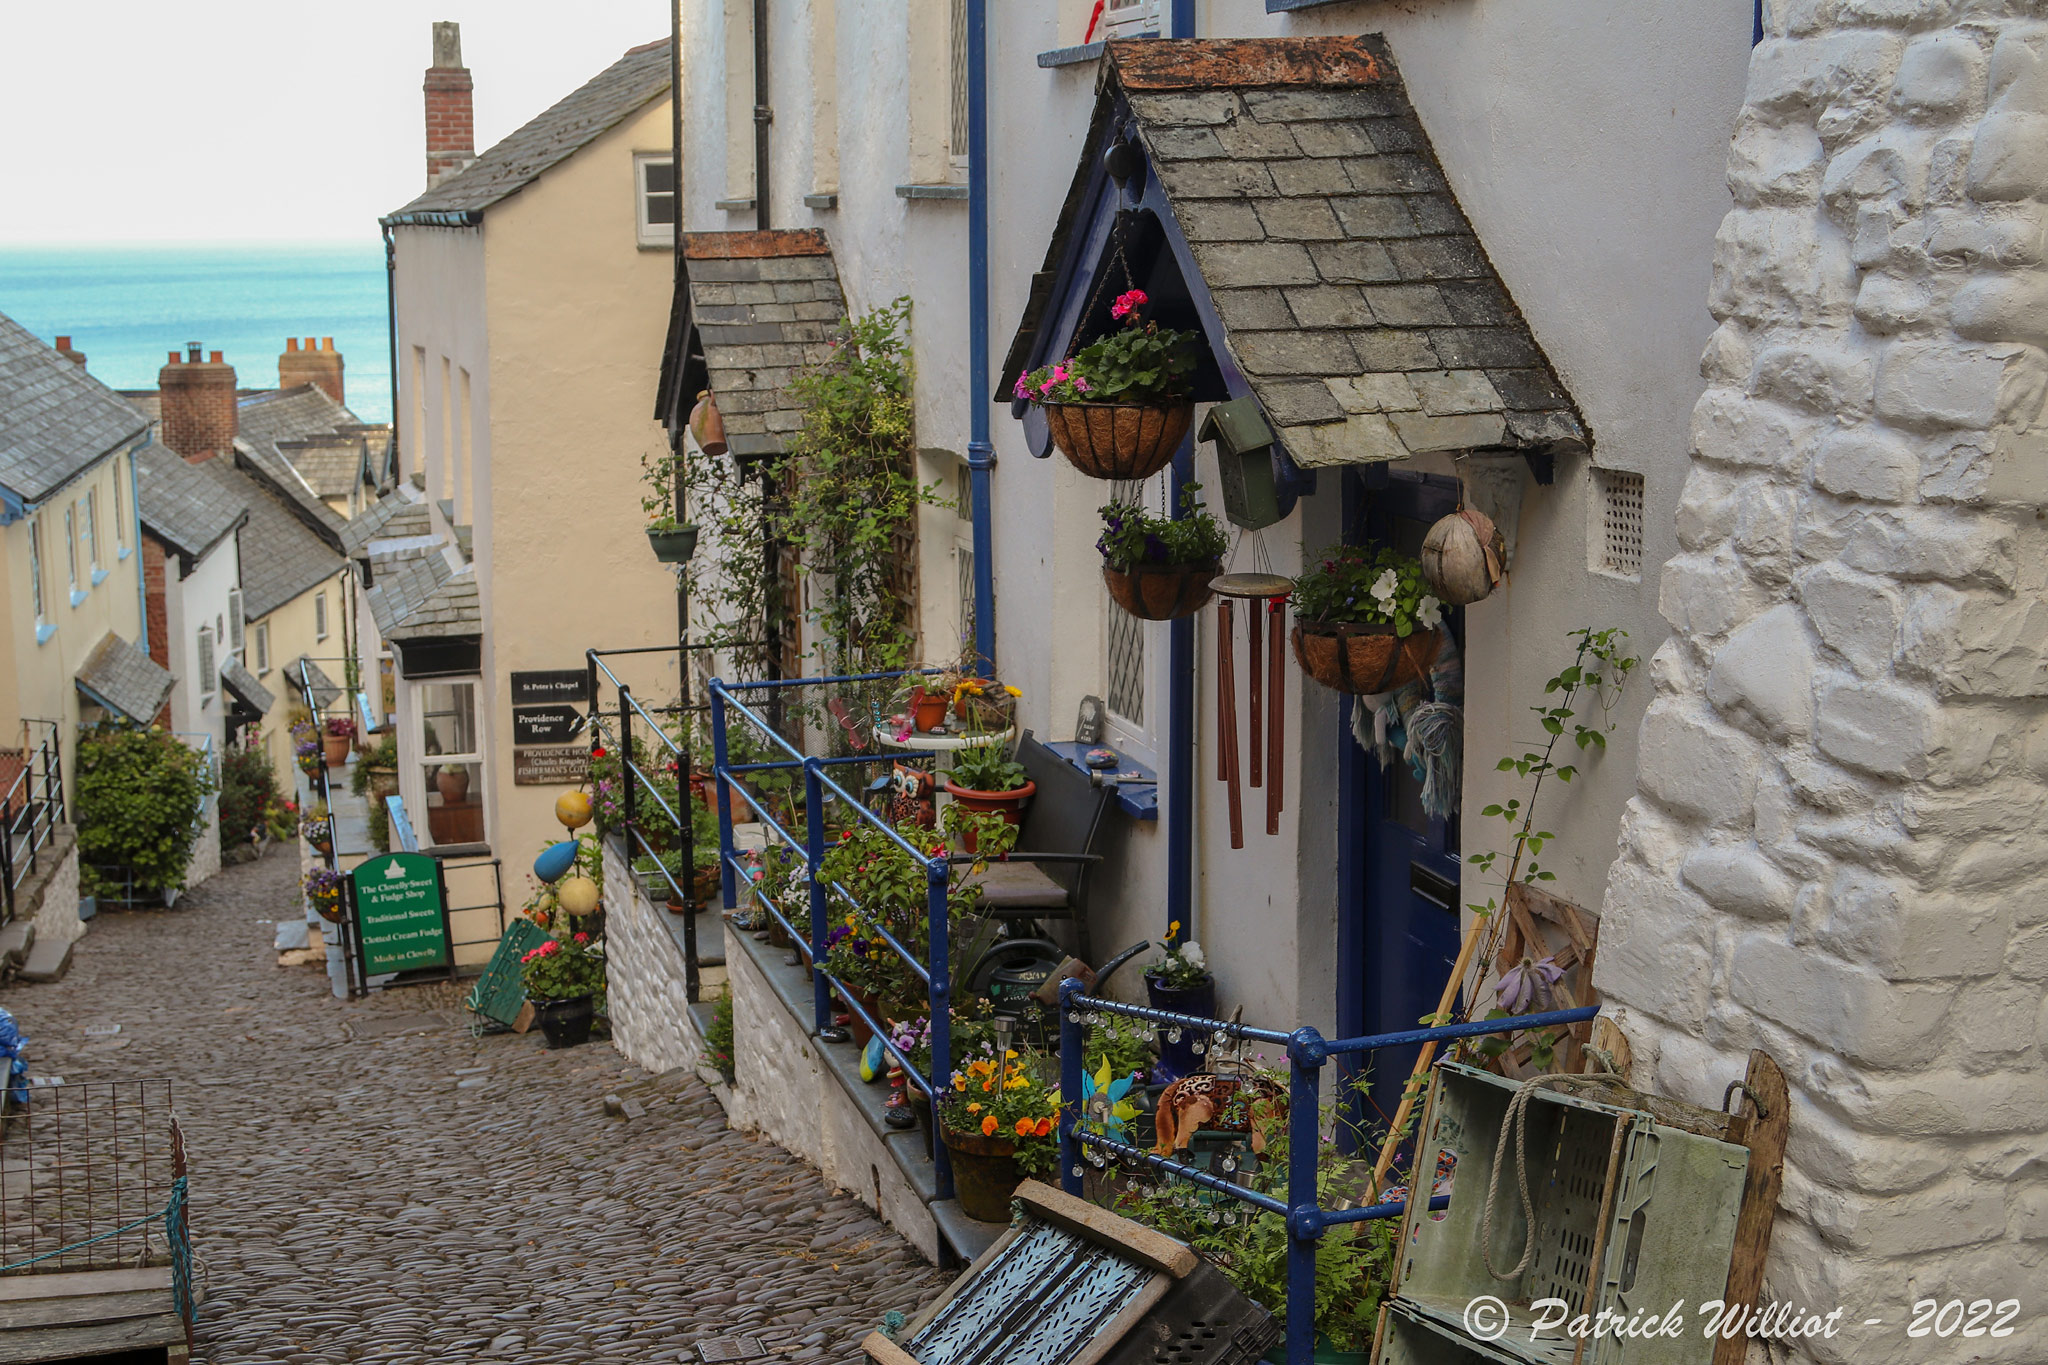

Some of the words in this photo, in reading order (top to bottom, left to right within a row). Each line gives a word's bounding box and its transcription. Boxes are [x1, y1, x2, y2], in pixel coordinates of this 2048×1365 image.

[555, 682, 578, 690] Chapel
[518, 714, 564, 723] Providence
[532, 724, 552, 733] Row
[524, 749, 570, 758] PROVIDENCE
[361, 886, 376, 894] The
[378, 882, 408, 892] Clovelly
[409, 879, 432, 888] Sweet
[380, 893, 404, 902] Fudge
[405, 890, 426, 898] Shop
[366, 912, 408, 924] Traditional
[408, 910, 434, 918] Sweets
[363, 934, 392, 944] Clotted
[392, 932, 418, 940] Cream
[420, 928, 443, 936] Fudge
[374, 954, 396, 963] Made
[406, 948, 436, 958] Clovelly
